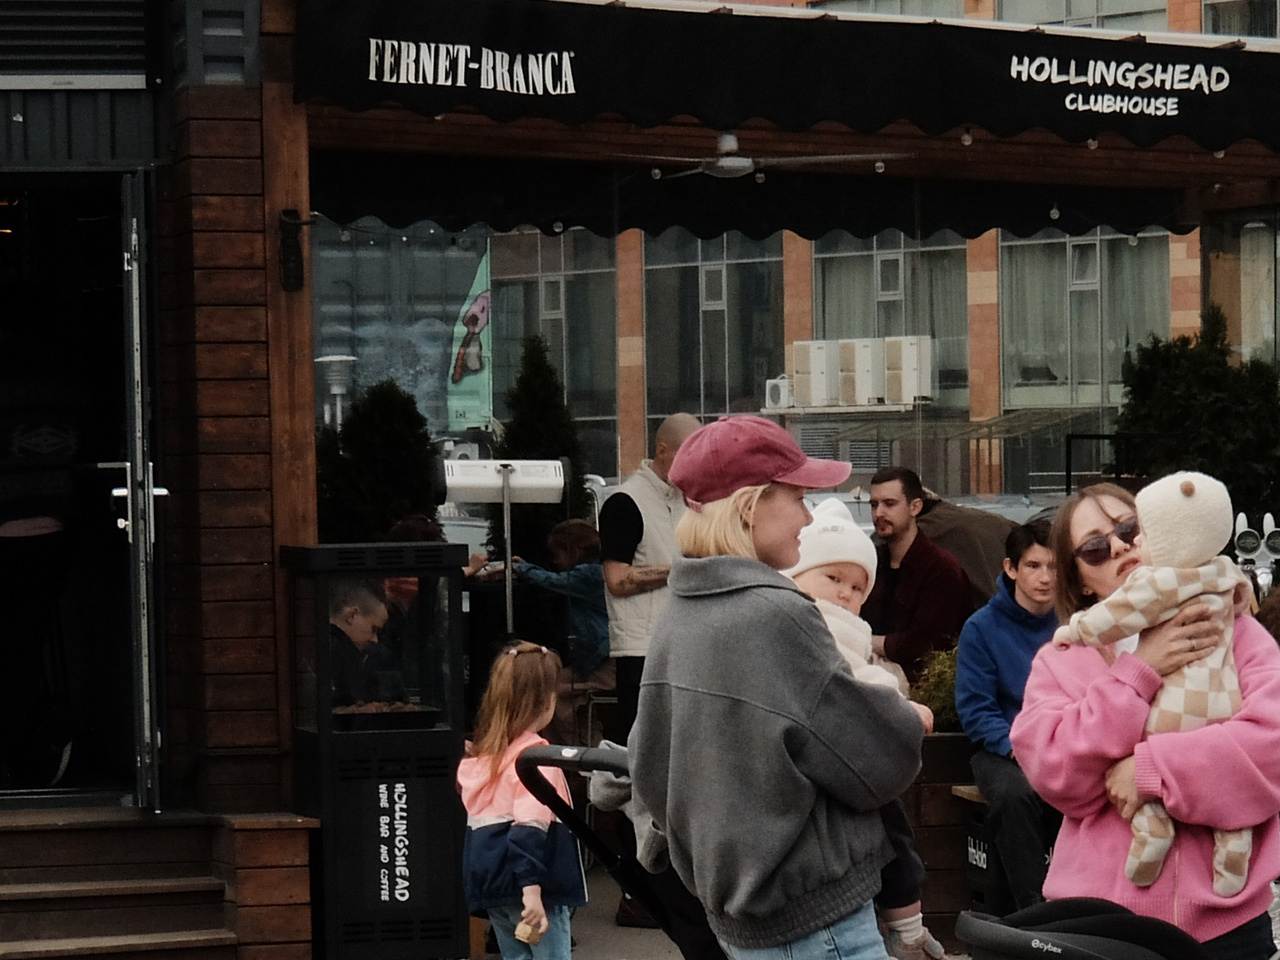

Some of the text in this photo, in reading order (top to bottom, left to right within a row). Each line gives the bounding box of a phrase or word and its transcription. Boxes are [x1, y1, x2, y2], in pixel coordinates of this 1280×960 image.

[368, 38, 576, 95] FERNET-BRANCA
[1010, 54, 1230, 95] HOLLINGSHEAD
[1064, 93, 1179, 116] CLUBHOUSE
[379, 784, 390, 901] WINE BAR AND COFFEE
[394, 783, 409, 901] HOLLINGSHEAD
